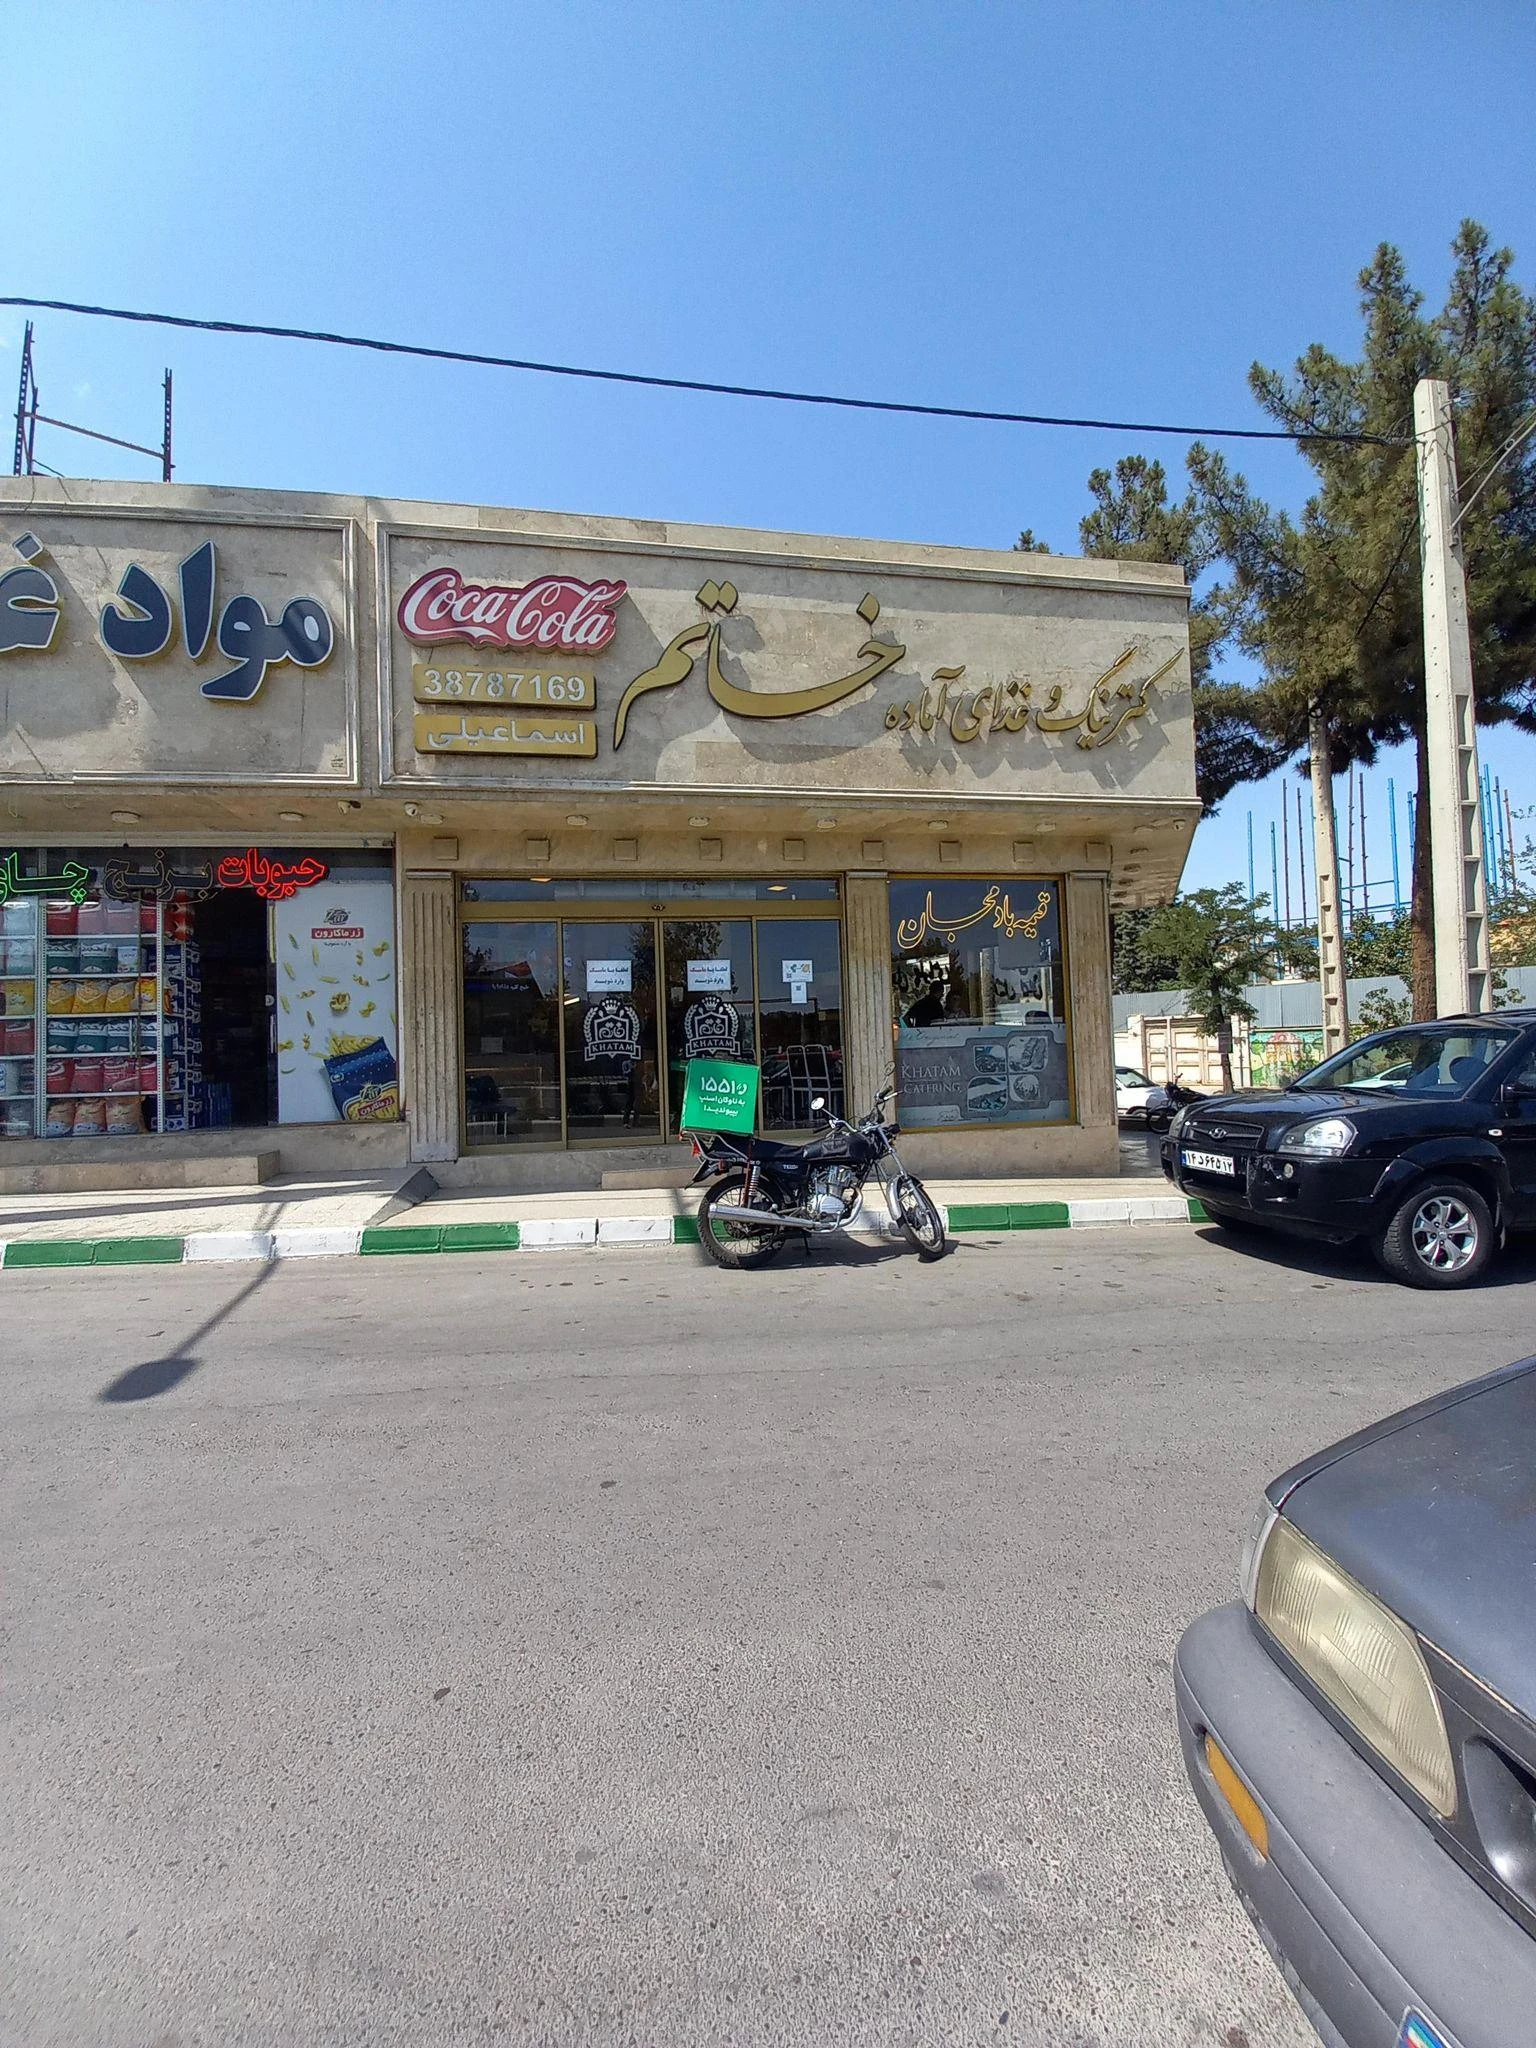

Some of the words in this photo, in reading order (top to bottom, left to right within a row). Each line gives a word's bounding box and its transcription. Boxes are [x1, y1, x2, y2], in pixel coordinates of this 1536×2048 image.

[99, 539, 334, 700] مواد
[403, 573, 622, 645] Coca-Cola
[423, 669, 586, 701] 38787169
[612, 578, 907, 751] خاتم
[885, 664, 966, 731] آماده
[950, 680, 1032, 743] غذای
[1035, 645, 1185, 751] کترینگ
[1044, 685, 1063, 713] و
[427, 717, 585, 749] اسماعیلی
[0, 851, 89, 905] چا
[102, 848, 213, 901] برنج
[217, 847, 326, 900] حبوبات
[897, 885, 1014, 949] بادمجان
[1013, 891, 1051, 939] قیمه
[592, 1042, 633, 1052] KHATAM
[692, 1039, 733, 1049] KHATAM
[701, 1077, 735, 1094] ۱۵۵۱
[901, 1065, 961, 1078] KHATAM
[903, 1082, 961, 1094] CATERING
[699, 1095, 718, 1103] اسنپ
[737, 1099, 746, 1107] به
